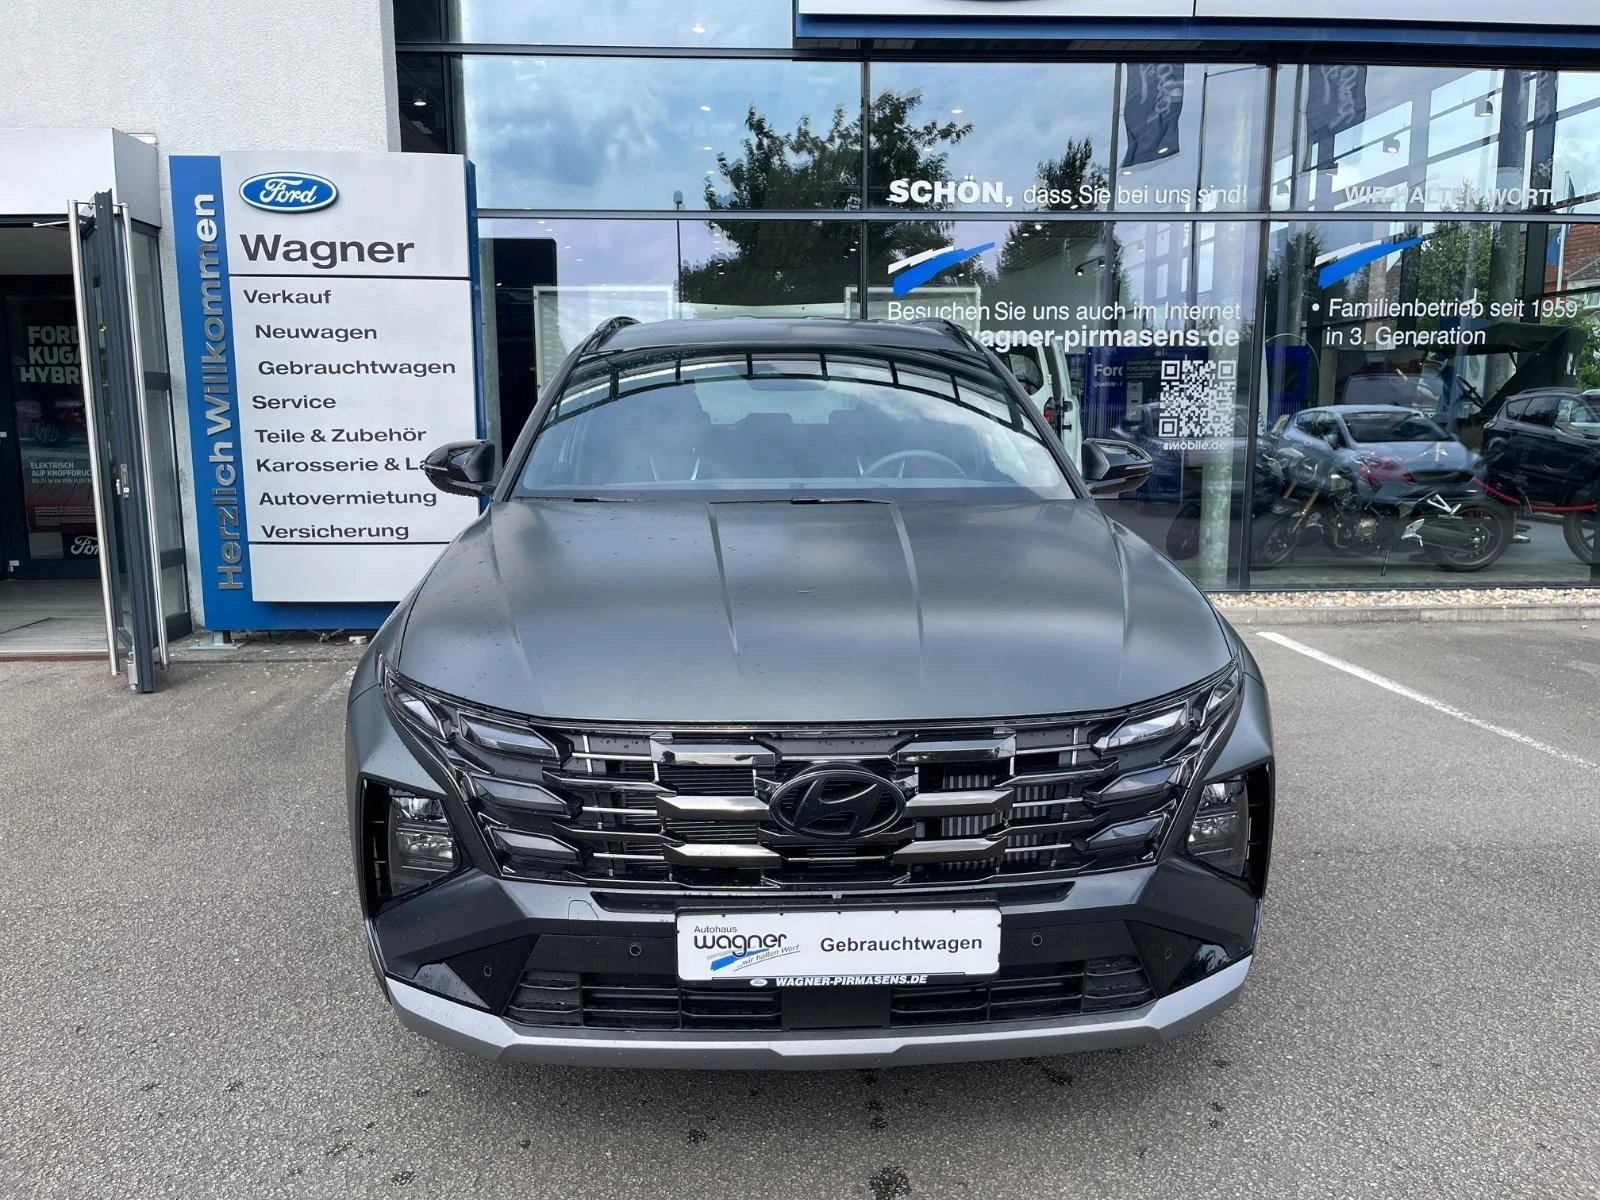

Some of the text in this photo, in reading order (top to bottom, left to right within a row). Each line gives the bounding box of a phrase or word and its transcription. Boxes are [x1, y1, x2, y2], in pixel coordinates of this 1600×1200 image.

[259, 178, 318, 203] Ford
[886, 175, 1249, 207] SCHÖN, dass Sie bei uns sind!
[1345, 186, 1386, 203] WIR
[1398, 187, 1482, 205] HALTEN
[239, 233, 415, 270] Wagner
[243, 289, 332, 304] Verkauf
[888, 301, 1241, 321] Besuchen Sie uns auch im Internet
[1329, 298, 1579, 319] Familienbetrieb seit 1959
[255, 324, 378, 343] Neuwagen
[1326, 326, 1486, 346] in 3. Generation
[20, 366, 83, 385] HYBR
[258, 360, 456, 378] Gebrauchtwagen
[194, 193, 244, 590] Herzlich Willkommen
[252, 395, 337, 410] Service
[255, 427, 427, 443] Teile & Zubehör
[256, 457, 379, 473] Karosserie
[384, 457, 400, 471] &
[259, 491, 437, 507] Autovermietung
[261, 525, 409, 541] Versicherung
[694, 933, 787, 958] wagner
[755, 950, 779, 961] halten
[781, 943, 800, 954] Wort
[820, 937, 983, 954] Gebrauchtwagen
[775, 974, 928, 987] WAGNER-PIRMASENS.DE
